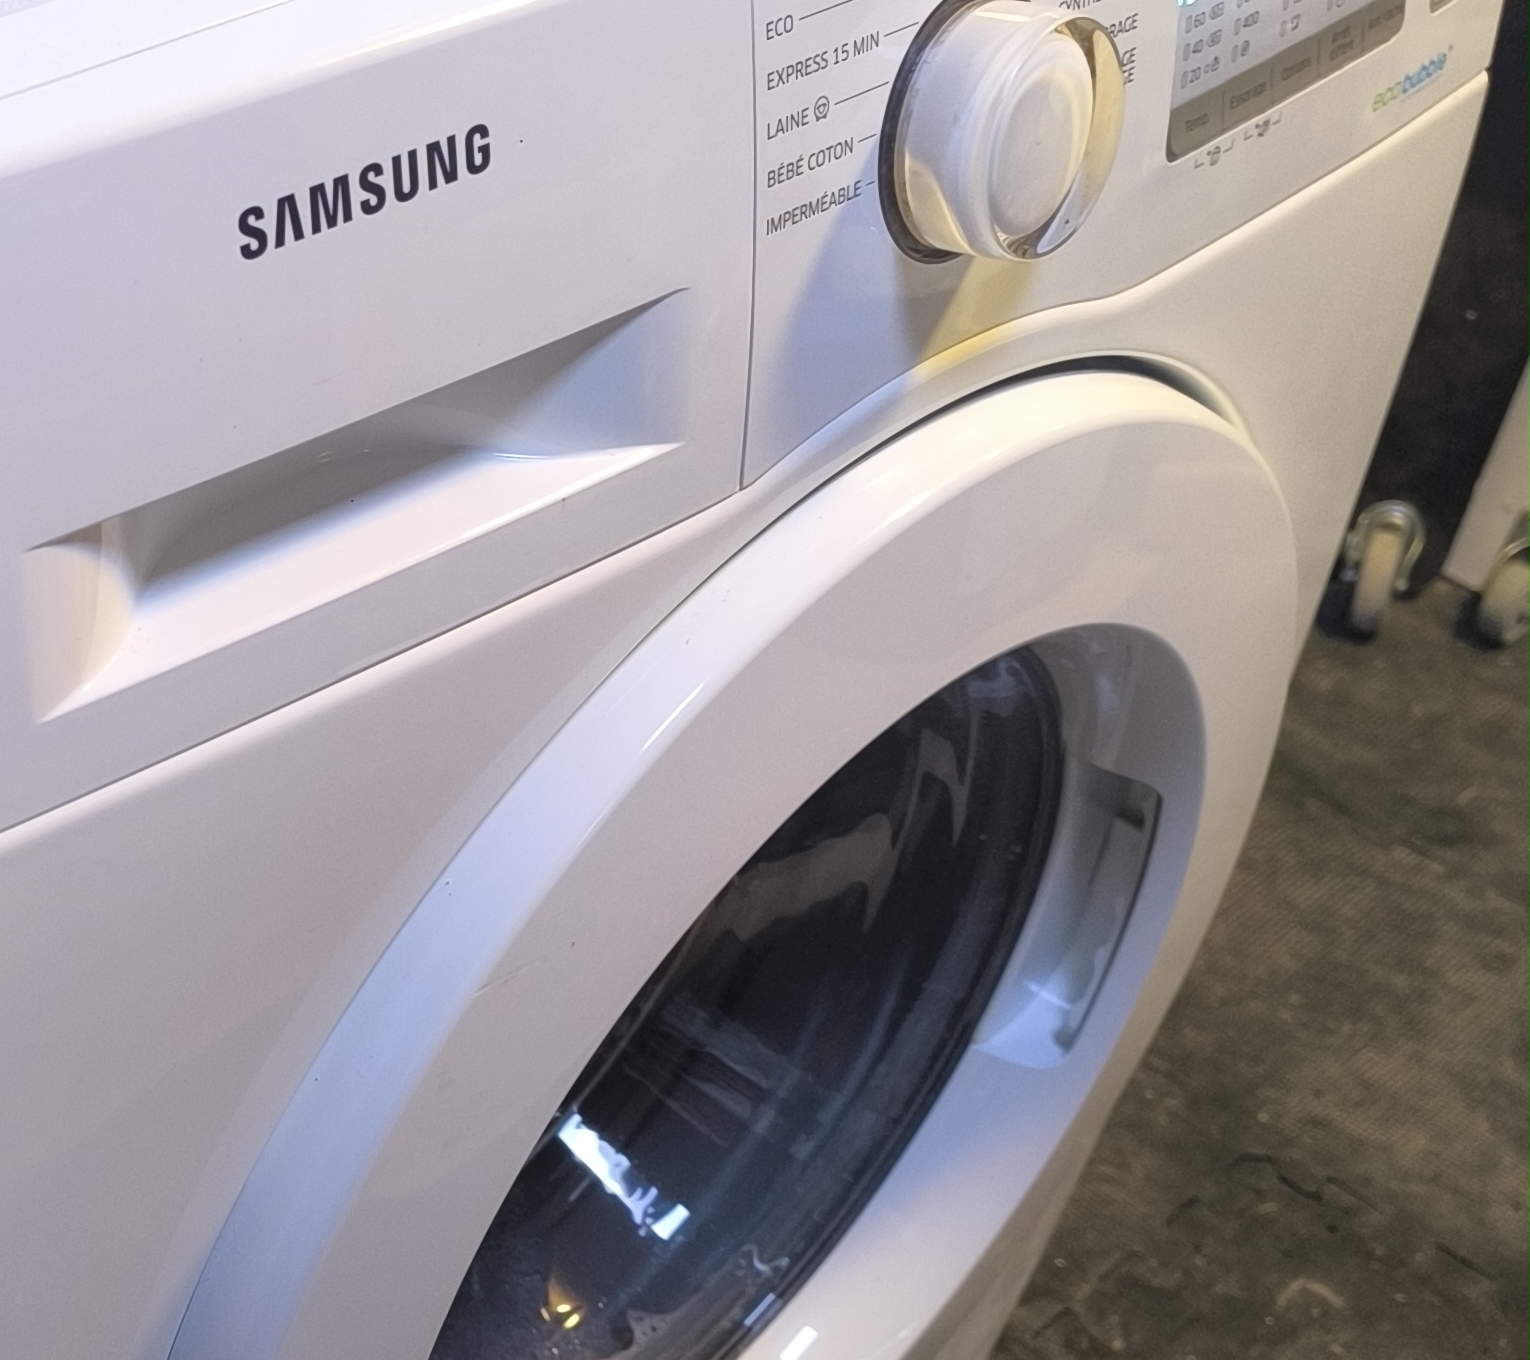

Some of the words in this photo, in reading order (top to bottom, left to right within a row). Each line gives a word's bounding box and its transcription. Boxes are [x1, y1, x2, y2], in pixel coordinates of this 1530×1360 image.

[766, 14, 794, 41] ECO
[767, 50, 829, 91] EXPRESS
[833, 42, 850, 65] 15
[853, 30, 880, 58] MIN
[767, 106, 810, 141] LAINE
[767, 153, 805, 189] BÉBÉ
[807, 136, 854, 171] COTON
[238, 123, 491, 260] SAMSUNG
[766, 179, 863, 236] IMPERMÉABLE
